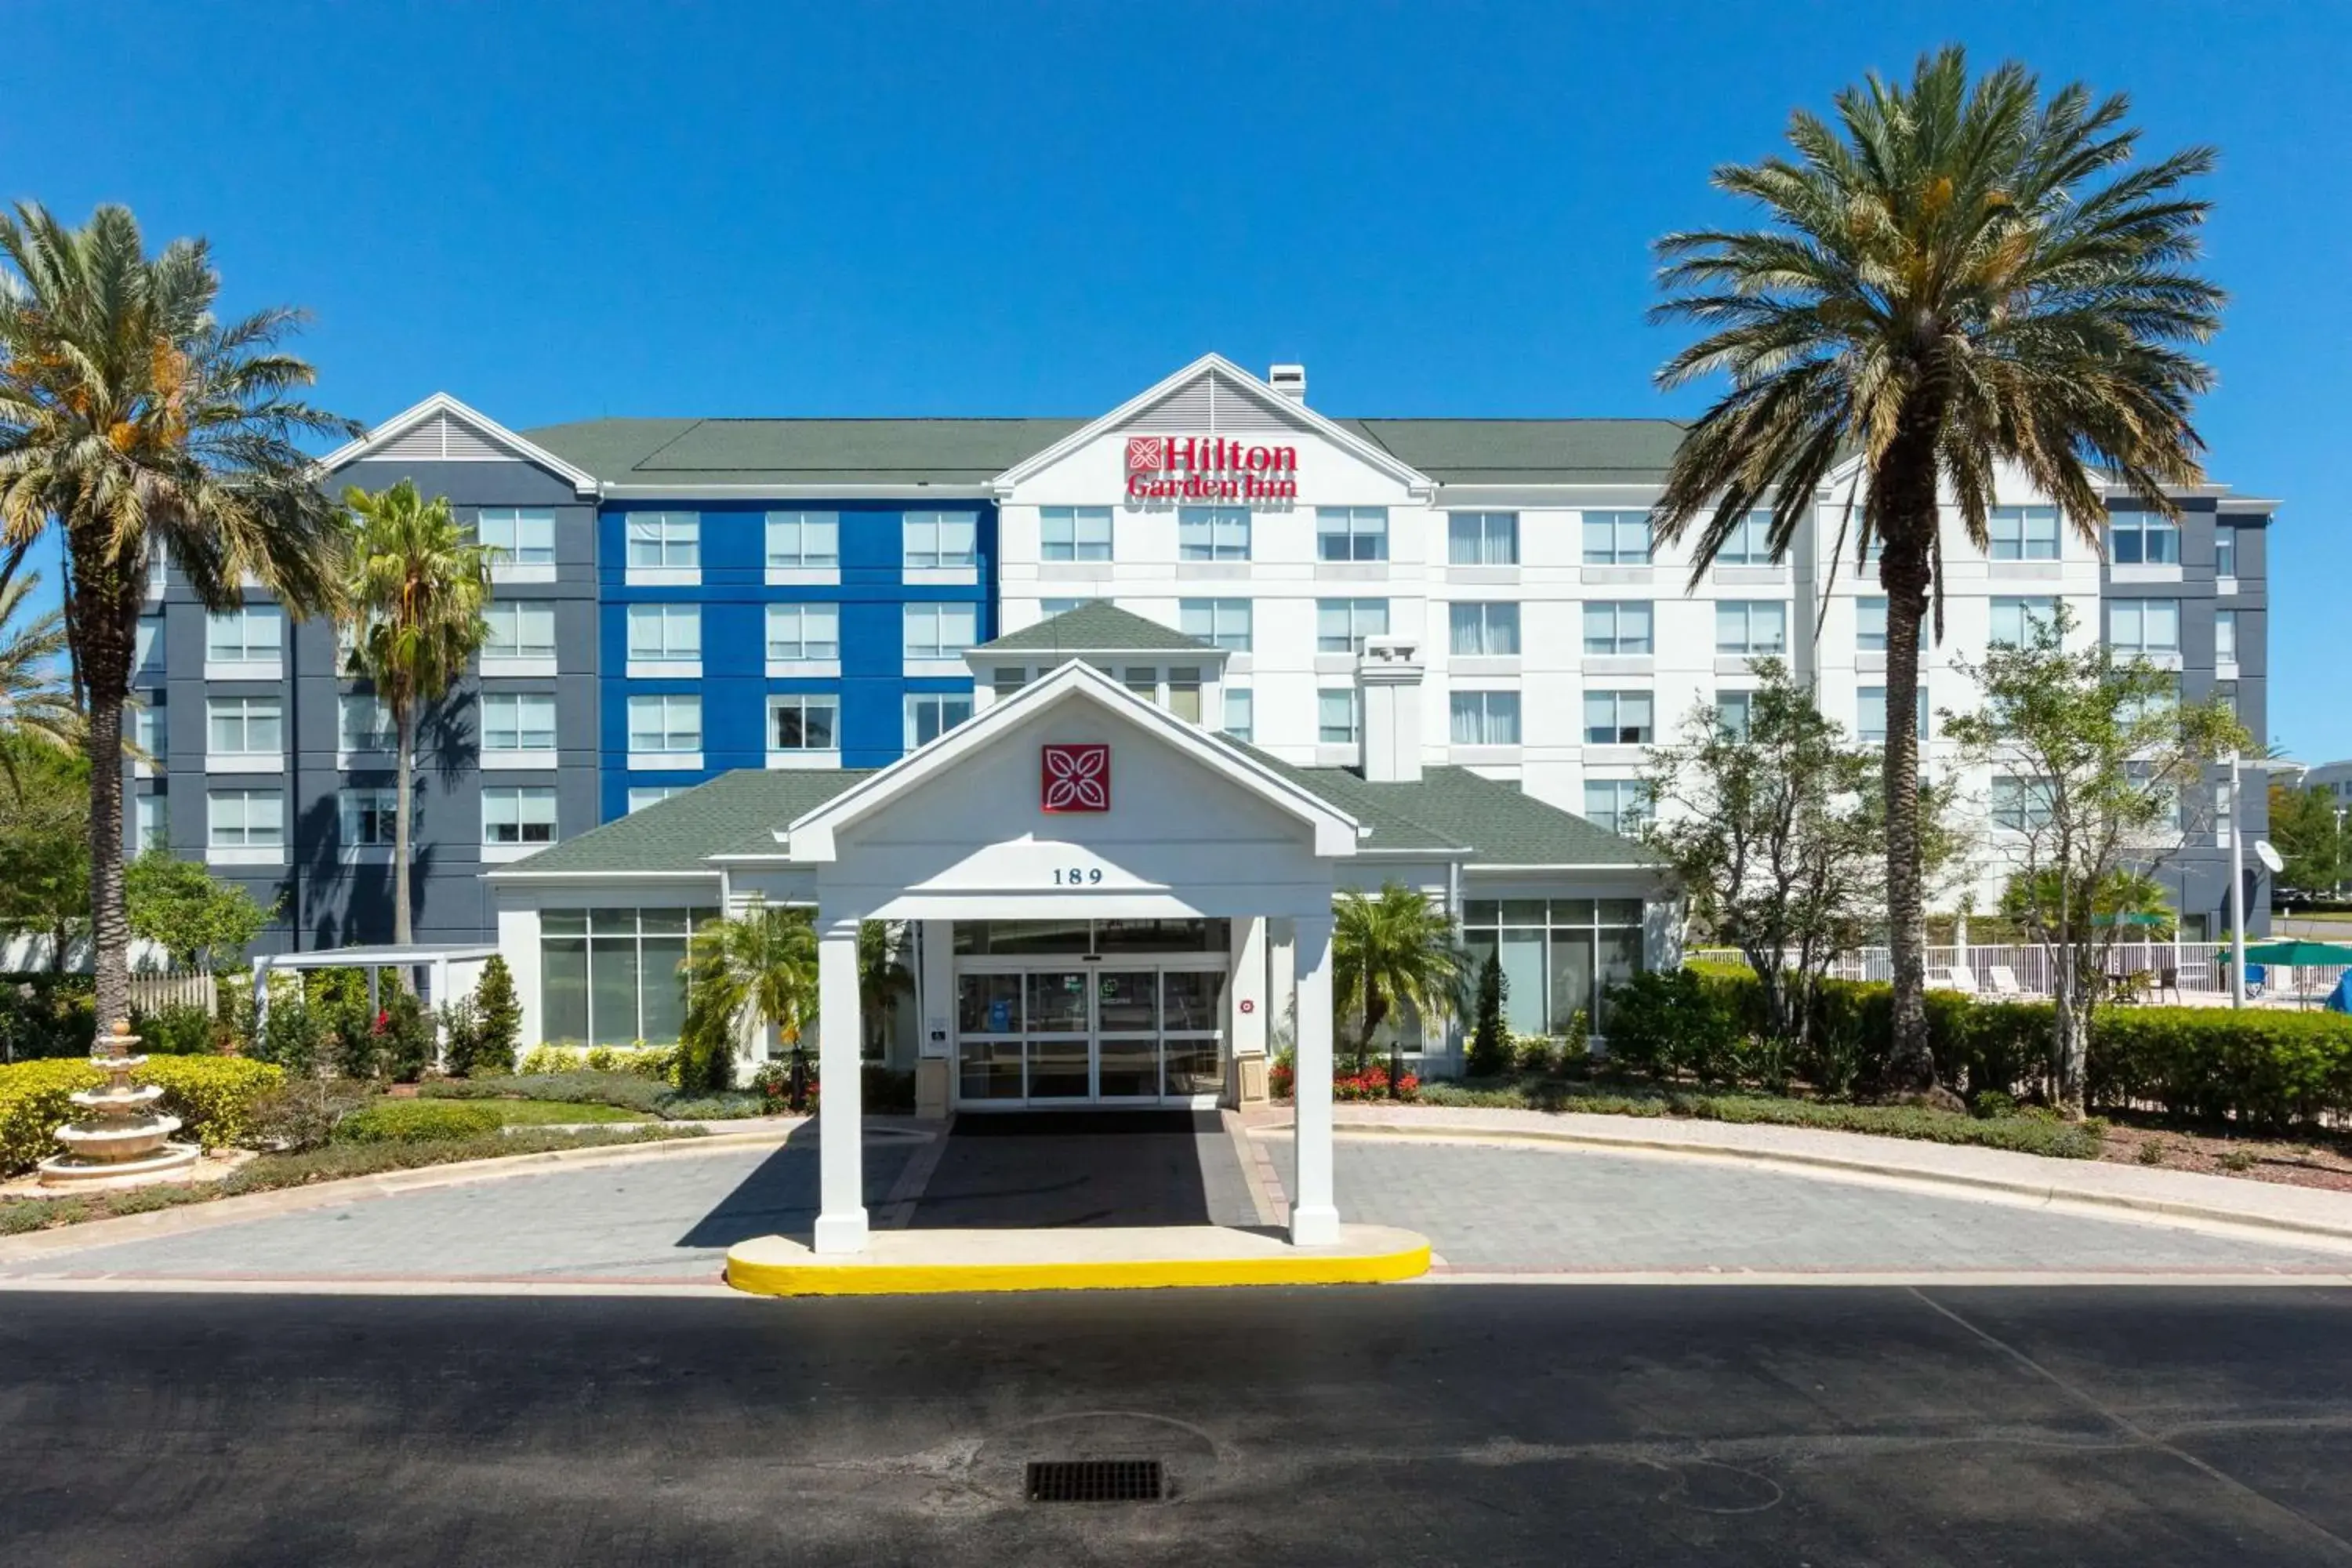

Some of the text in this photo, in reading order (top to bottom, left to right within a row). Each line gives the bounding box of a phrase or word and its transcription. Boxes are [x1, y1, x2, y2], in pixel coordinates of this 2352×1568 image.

[1166, 437, 1298, 471] Hilton
[1128, 474, 1298, 497] Garden Inn
[1054, 868, 1102, 884] 189
